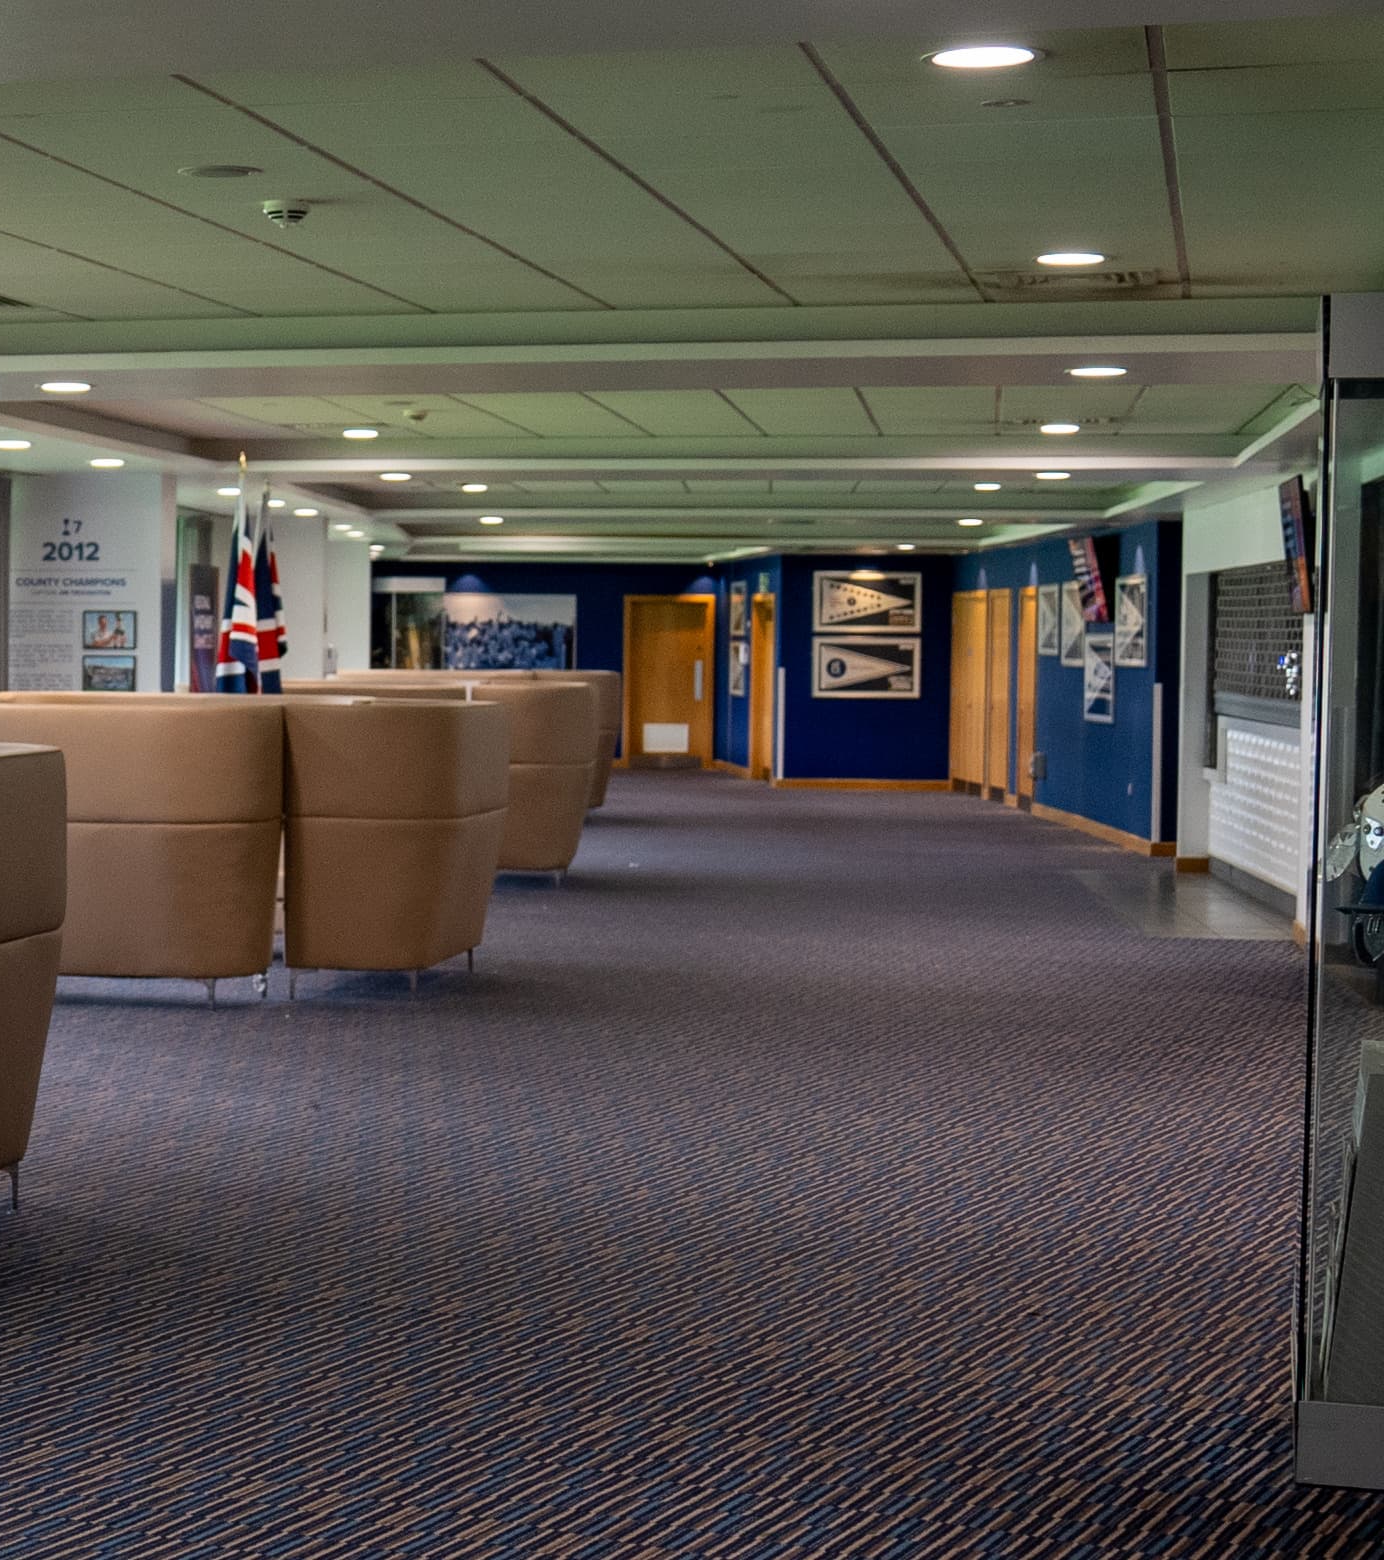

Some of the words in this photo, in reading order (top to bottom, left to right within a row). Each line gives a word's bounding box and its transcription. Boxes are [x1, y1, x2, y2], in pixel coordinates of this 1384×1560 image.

[72, 520, 83, 533] 7
[42, 541, 100, 561] 2012
[16, 577, 59, 587] COUNTY
[62, 577, 127, 587] CHAMPIONS
